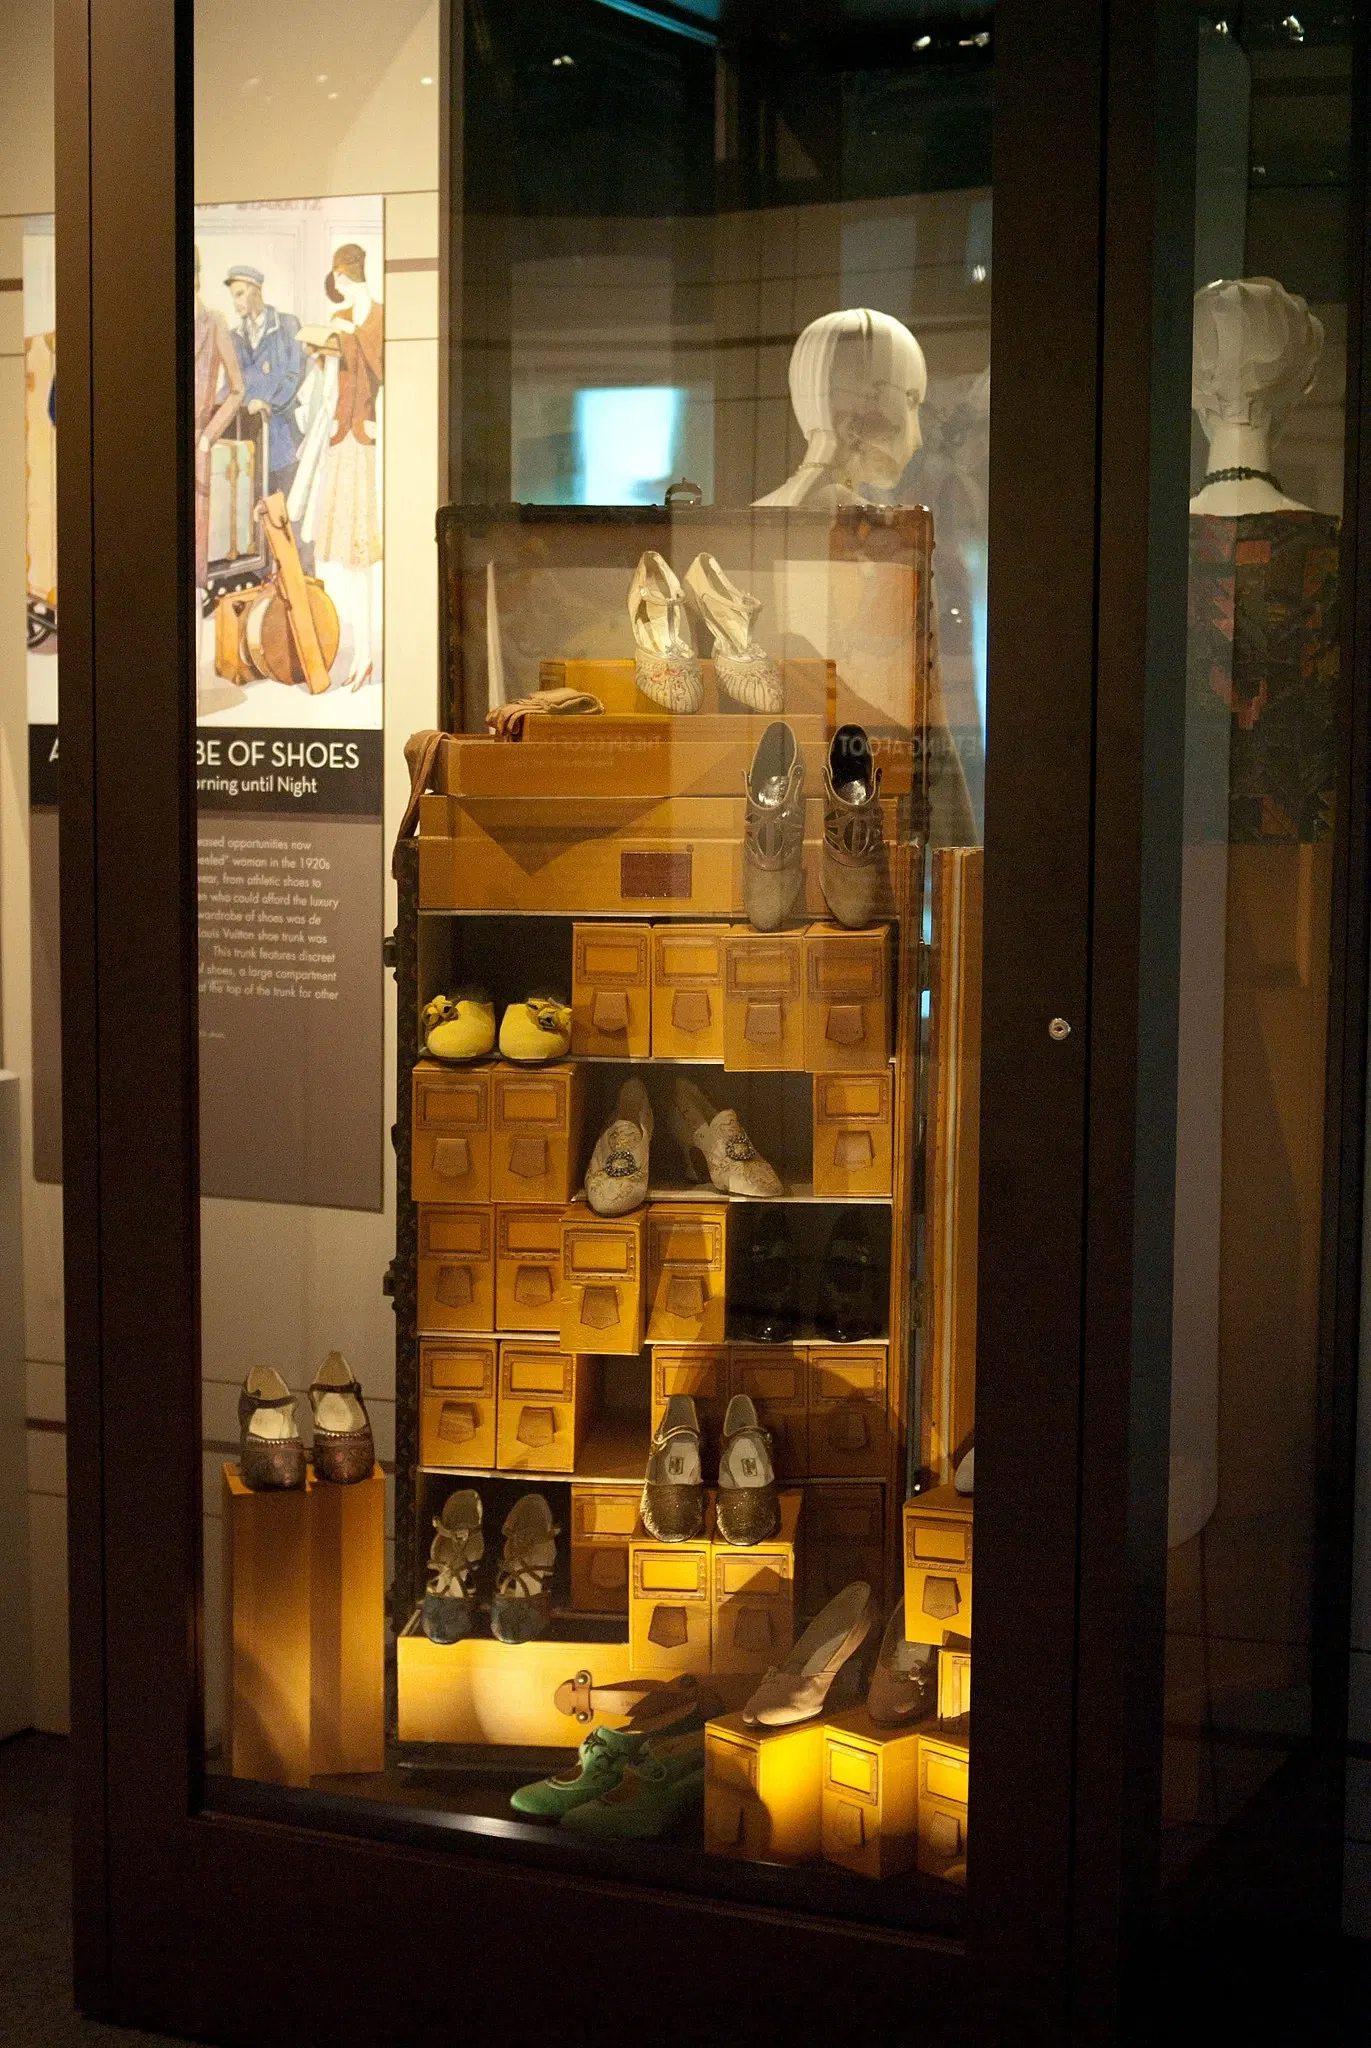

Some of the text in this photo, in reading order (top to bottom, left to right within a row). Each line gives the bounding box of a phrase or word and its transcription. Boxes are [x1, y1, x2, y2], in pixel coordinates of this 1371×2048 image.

[228, 740, 266, 767] OF
[271, 741, 360, 769] SHOES
[241, 774, 274, 792] until
[277, 775, 318, 798] Night
[227, 839, 289, 851] opportunities
[291, 842, 312, 850] now
[270, 857, 279, 868] in
[281, 856, 297, 868] the
[300, 857, 331, 870] 1920s
[222, 872, 244, 885] from
[247, 874, 281, 886] athletic
[283, 875, 310, 888] shoes
[311, 878, 322, 888] to
[210, 890, 231, 902] who
[233, 892, 260, 904] could
[261, 892, 290, 905] afford
[292, 895, 307, 906] the
[310, 894, 339, 910] luxury
[245, 910, 256, 921] of
[257, 911, 284, 923] shoes
[286, 915, 306, 924] was
[308, 913, 321, 925] de
[222, 928, 254, 940] Vuitton
[257, 929, 280, 941] shoe
[281, 931, 305, 943] trunk
[307, 935, 328, 944] was
[211, 945, 335, 963] This trunk features discreet
[206, 963, 236, 977] shoes,
[238, 968, 246, 977] a
[248, 964, 273, 980] large
[275, 970, 337, 982] compartment
[208, 980, 223, 993] the
[226, 985, 242, 996] top
[243, 984, 254, 995] of
[256, 984, 270, 996] the
[273, 987, 296, 998] trunk
[299, 985, 312, 998] for
[314, 988, 339, 1000] other
